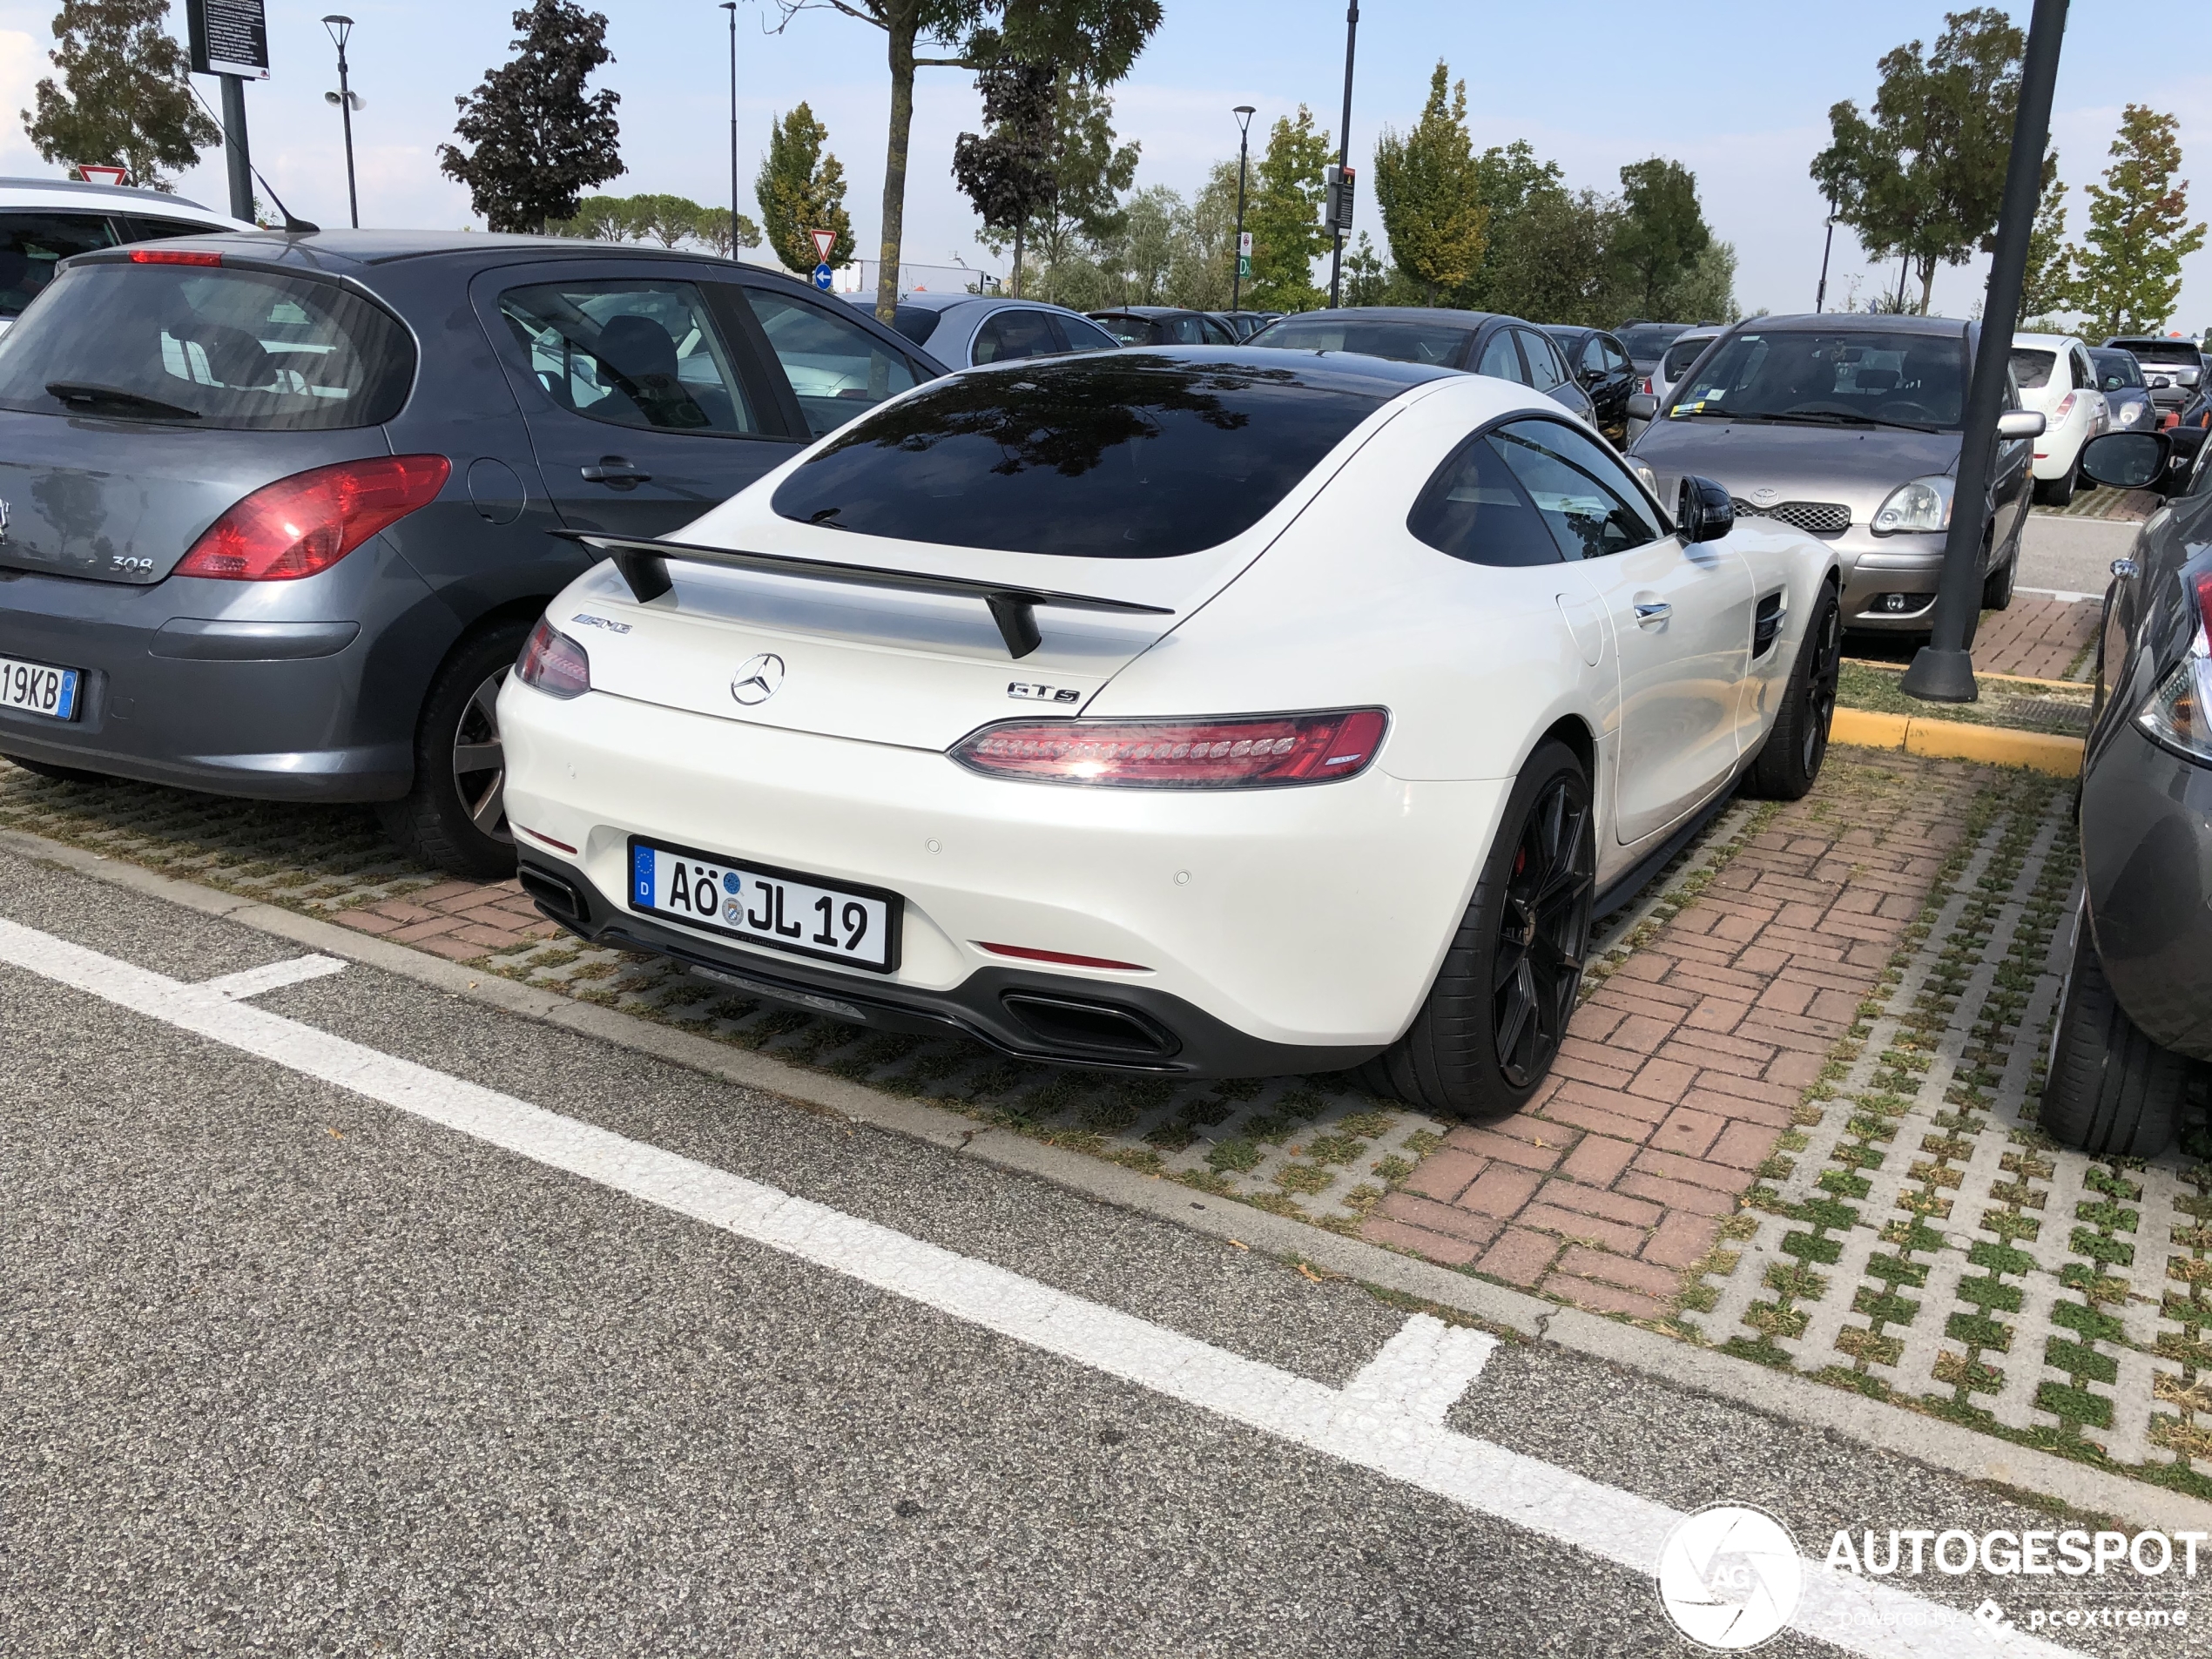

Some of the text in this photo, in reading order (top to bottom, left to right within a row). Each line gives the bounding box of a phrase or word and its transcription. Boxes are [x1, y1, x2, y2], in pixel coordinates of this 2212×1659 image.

[109, 556, 153, 575] 308
[3, 664, 58, 710] 19KB
[640, 881, 649, 896] D
[669, 861, 718, 916] AÖ
